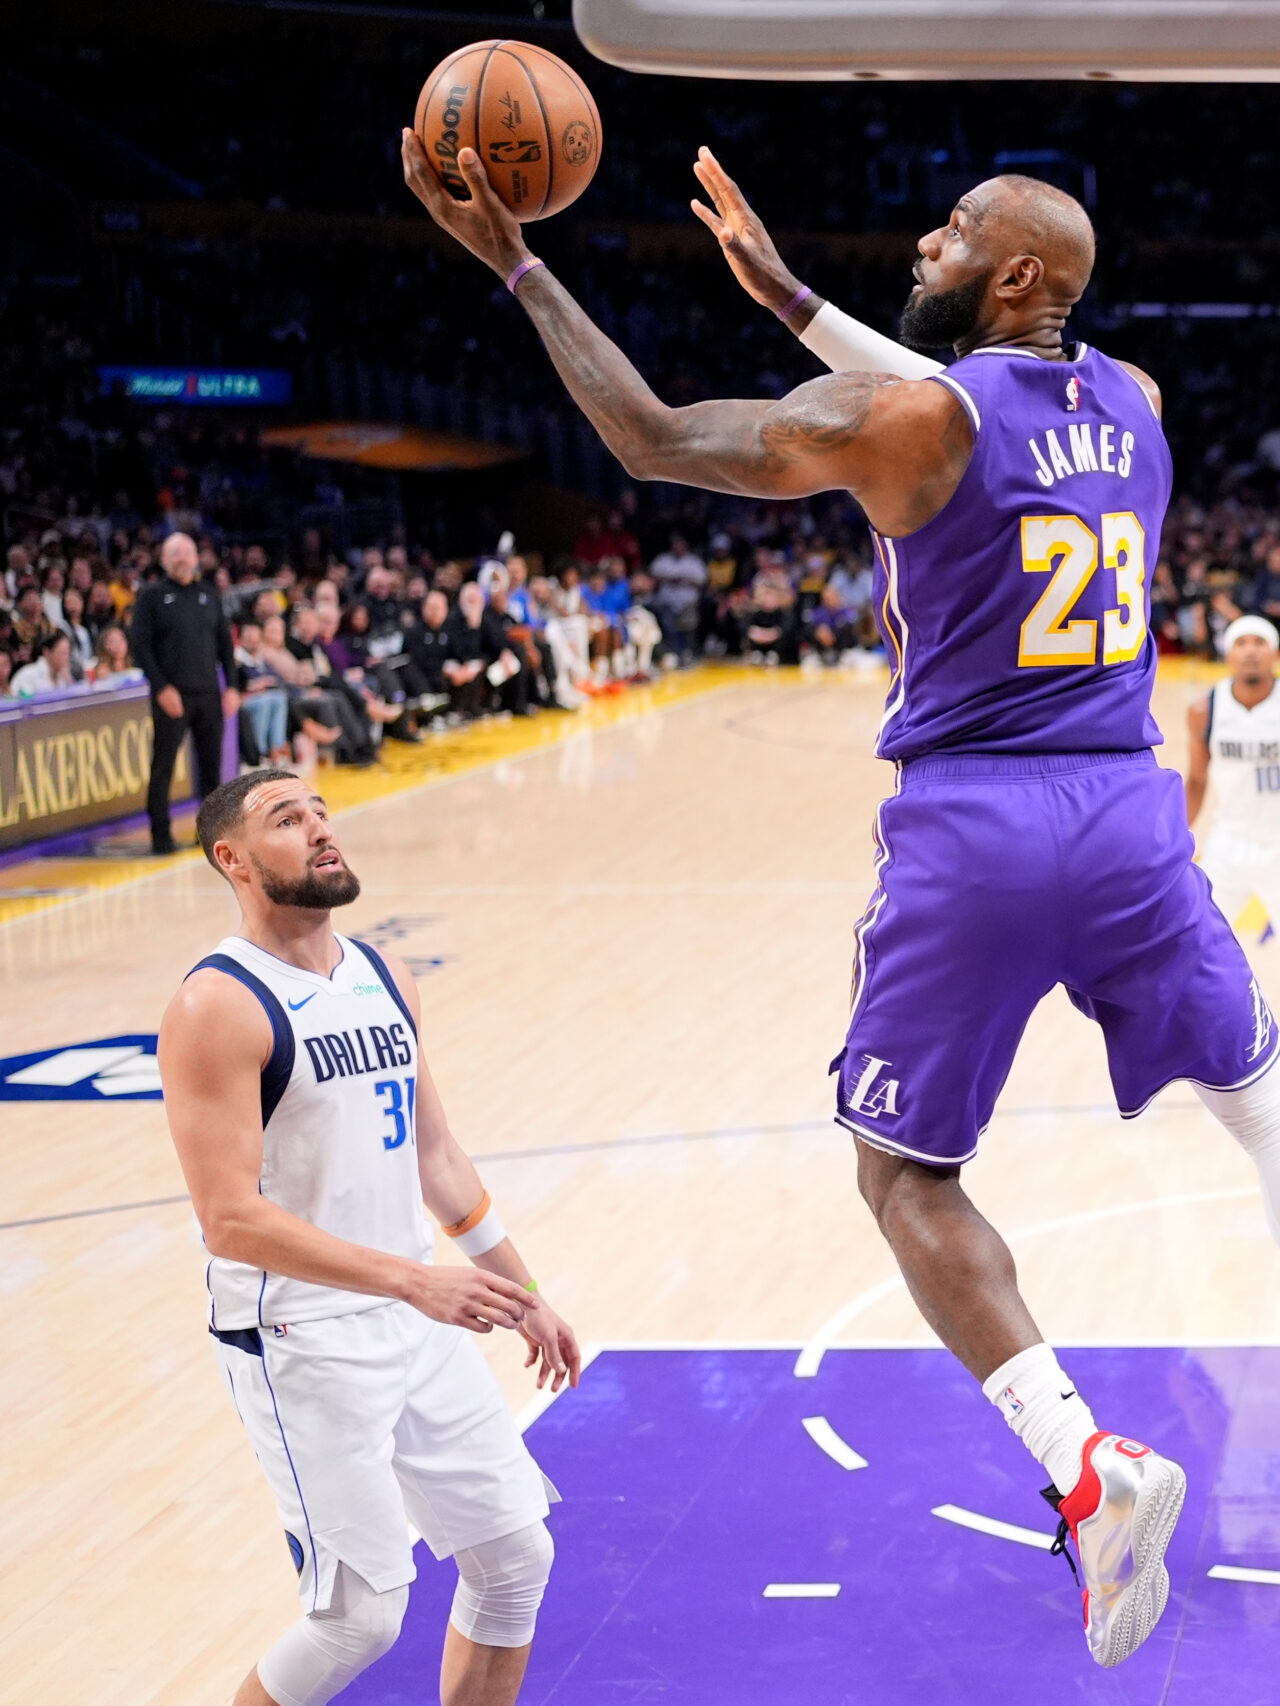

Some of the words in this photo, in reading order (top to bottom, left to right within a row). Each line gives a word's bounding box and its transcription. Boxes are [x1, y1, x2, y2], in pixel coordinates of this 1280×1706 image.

[1028, 423, 1135, 488] JAMES
[1017, 511, 1147, 668] 23
[352, 981, 385, 998] chime
[303, 1022, 412, 1085] DALLAS
[845, 1053, 903, 1119] LA
